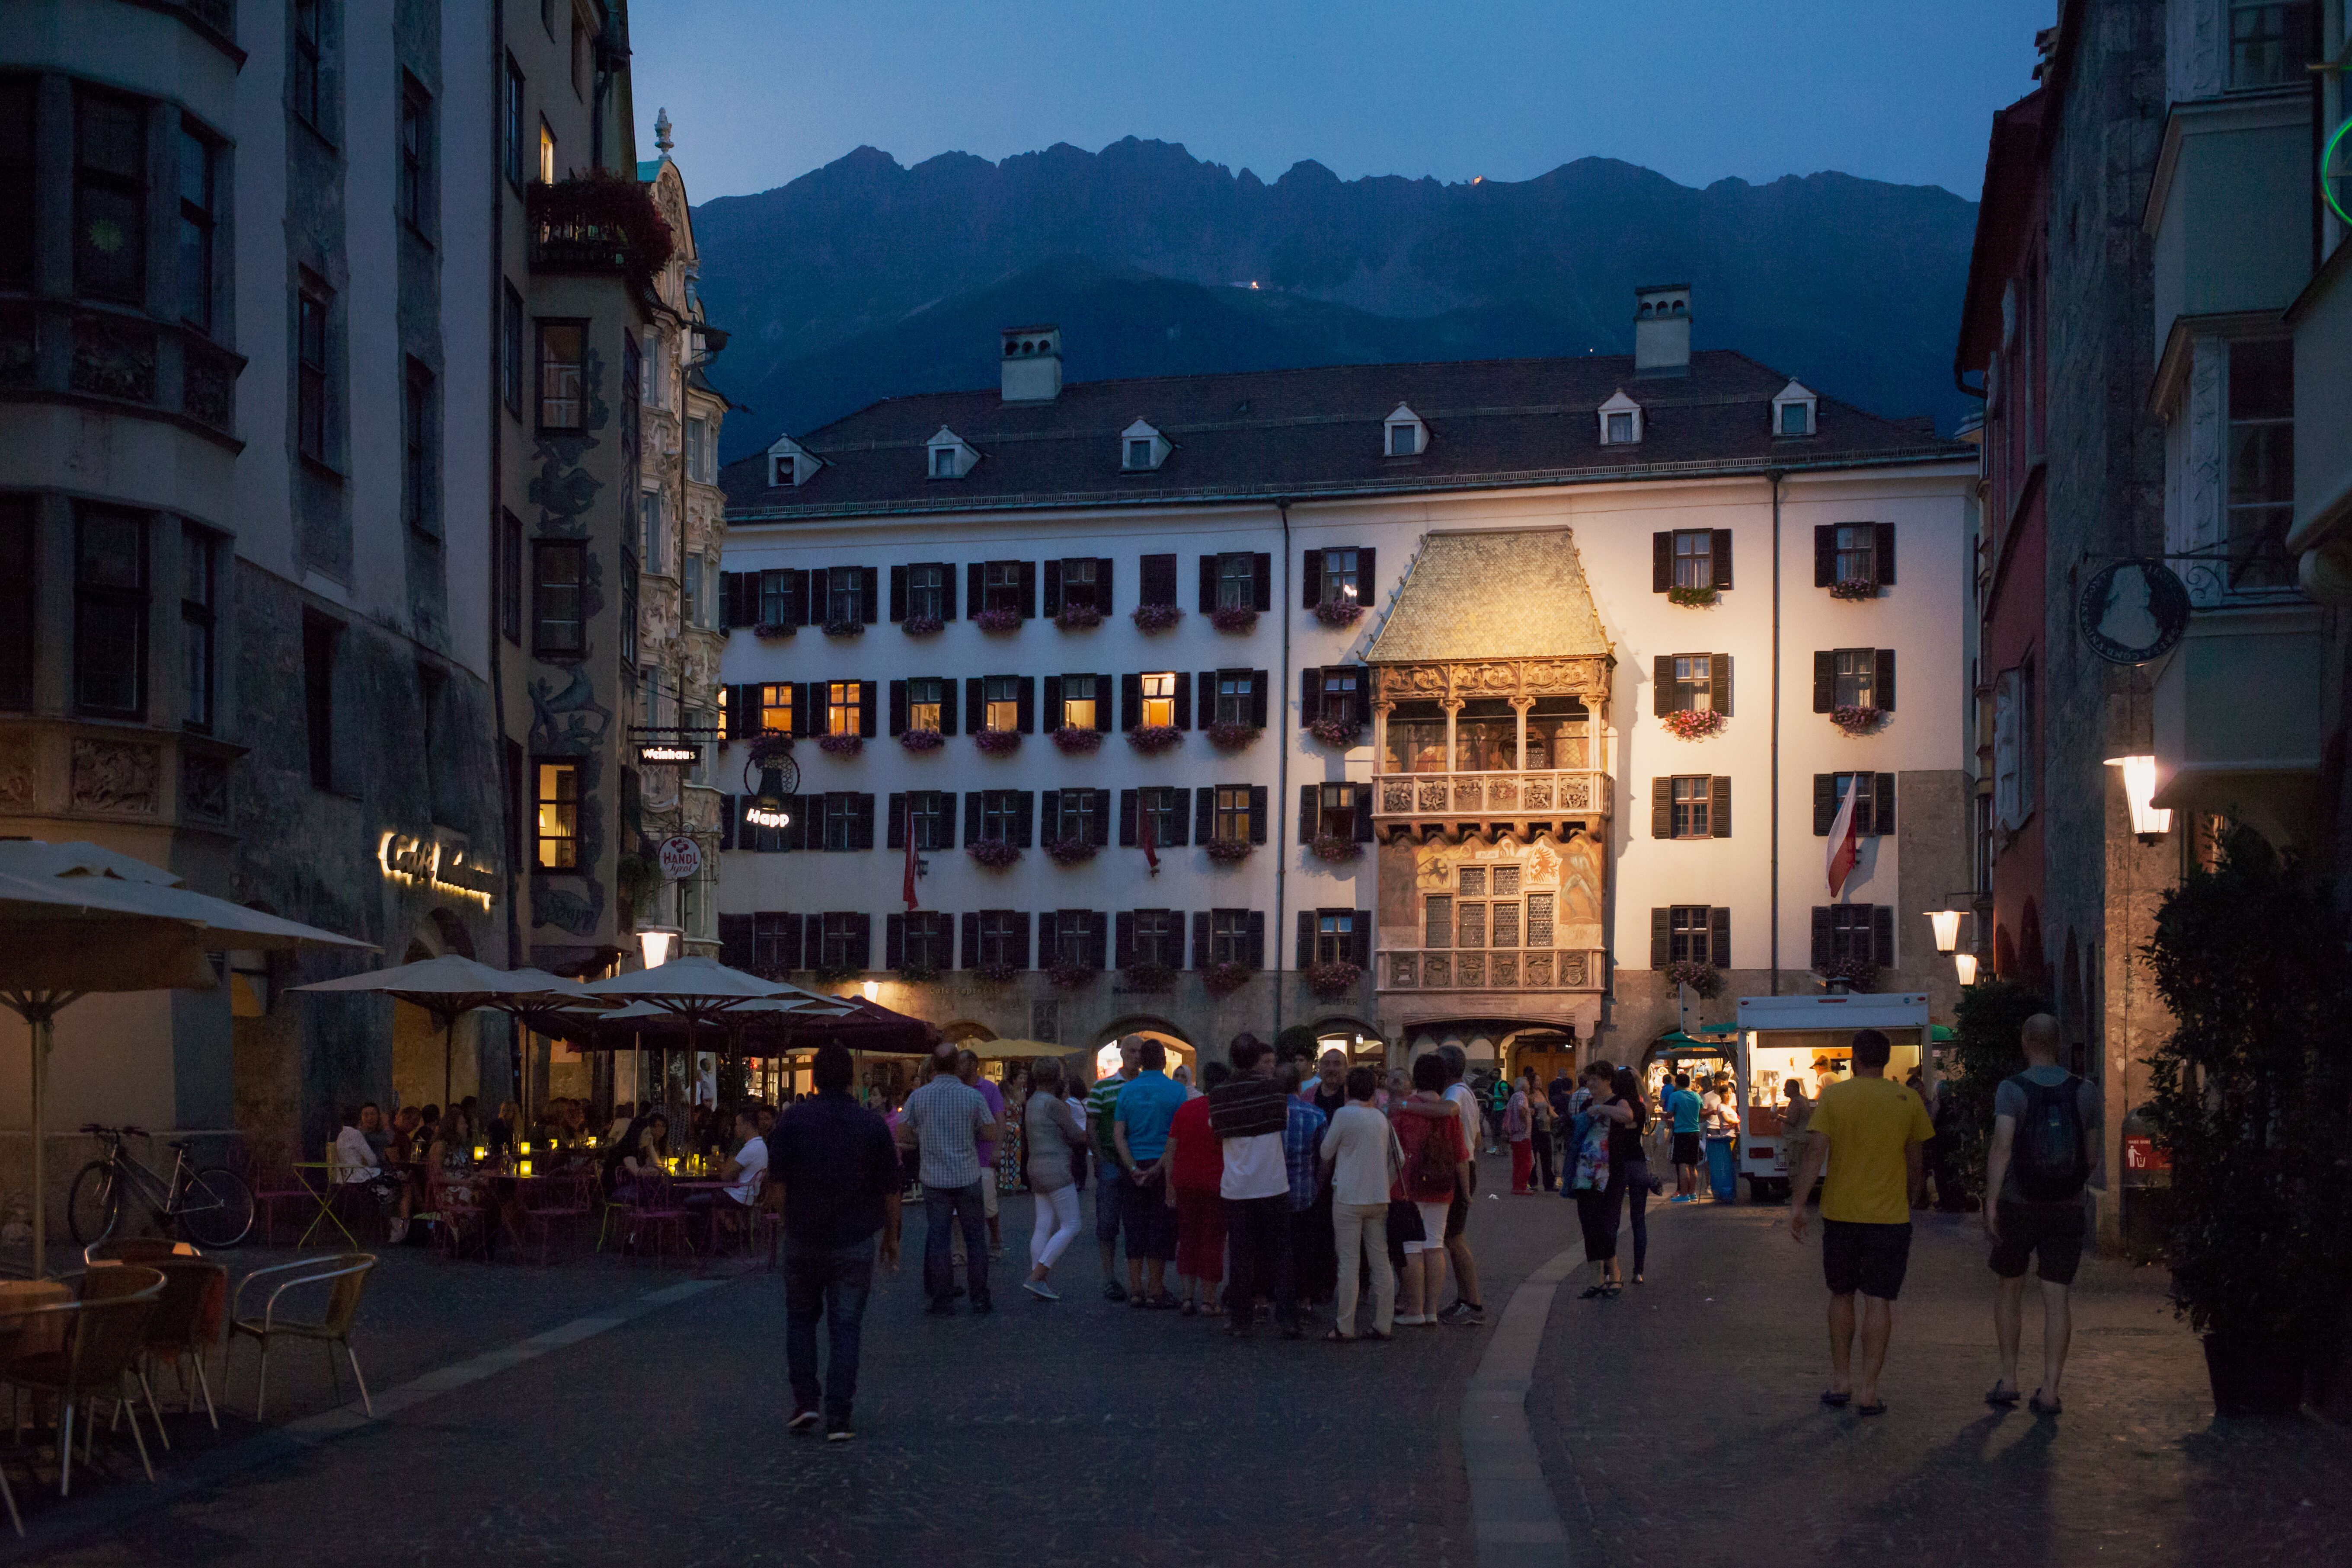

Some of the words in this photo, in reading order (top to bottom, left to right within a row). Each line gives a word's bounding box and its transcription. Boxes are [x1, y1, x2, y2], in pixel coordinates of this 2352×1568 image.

[641, 747, 696, 760] Weinhaus
[746, 808, 790, 828] Happ
[664, 852, 698, 864] HANDL
[666, 861, 693, 875] Tyrol
